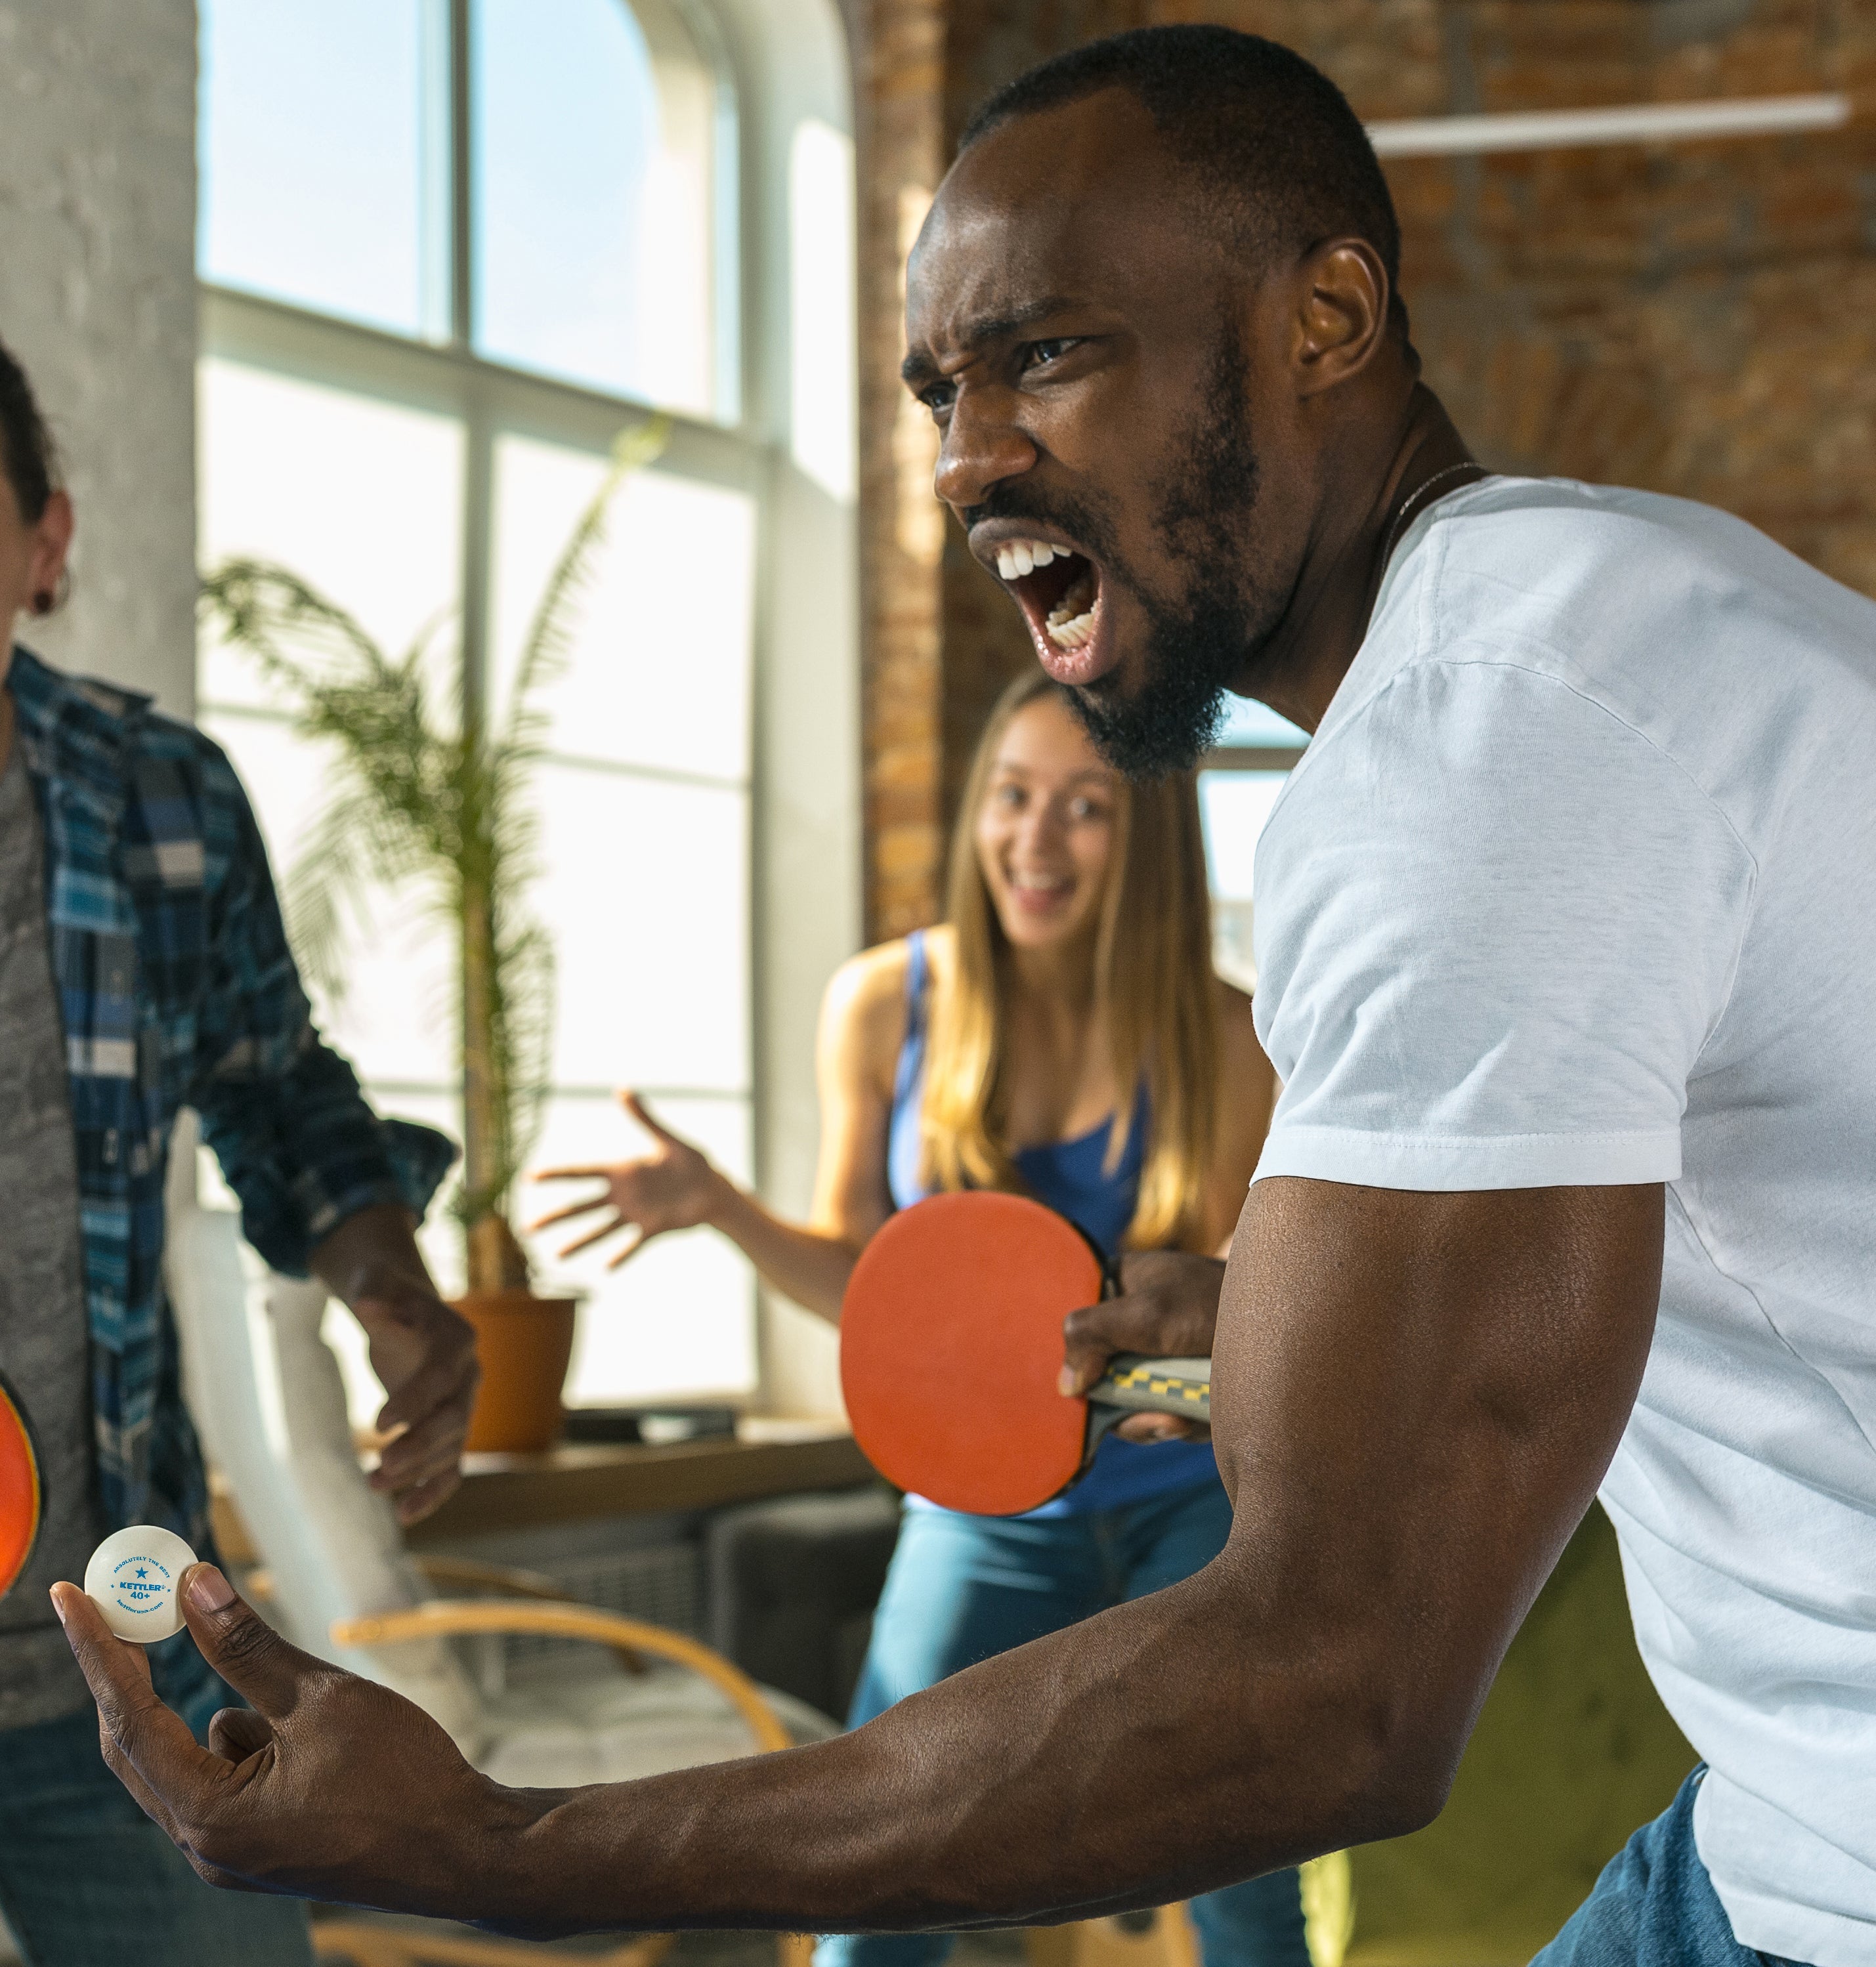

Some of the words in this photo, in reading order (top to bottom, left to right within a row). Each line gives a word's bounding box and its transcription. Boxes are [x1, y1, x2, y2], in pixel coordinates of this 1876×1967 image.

[114, 1556, 146, 1574] ABSOLUTELY
[148, 1557, 159, 1566] THE
[159, 1565, 170, 1578] BEST
[130, 1591, 150, 1599] 40+
[117, 1599, 163, 1614] kettlerusa.com
